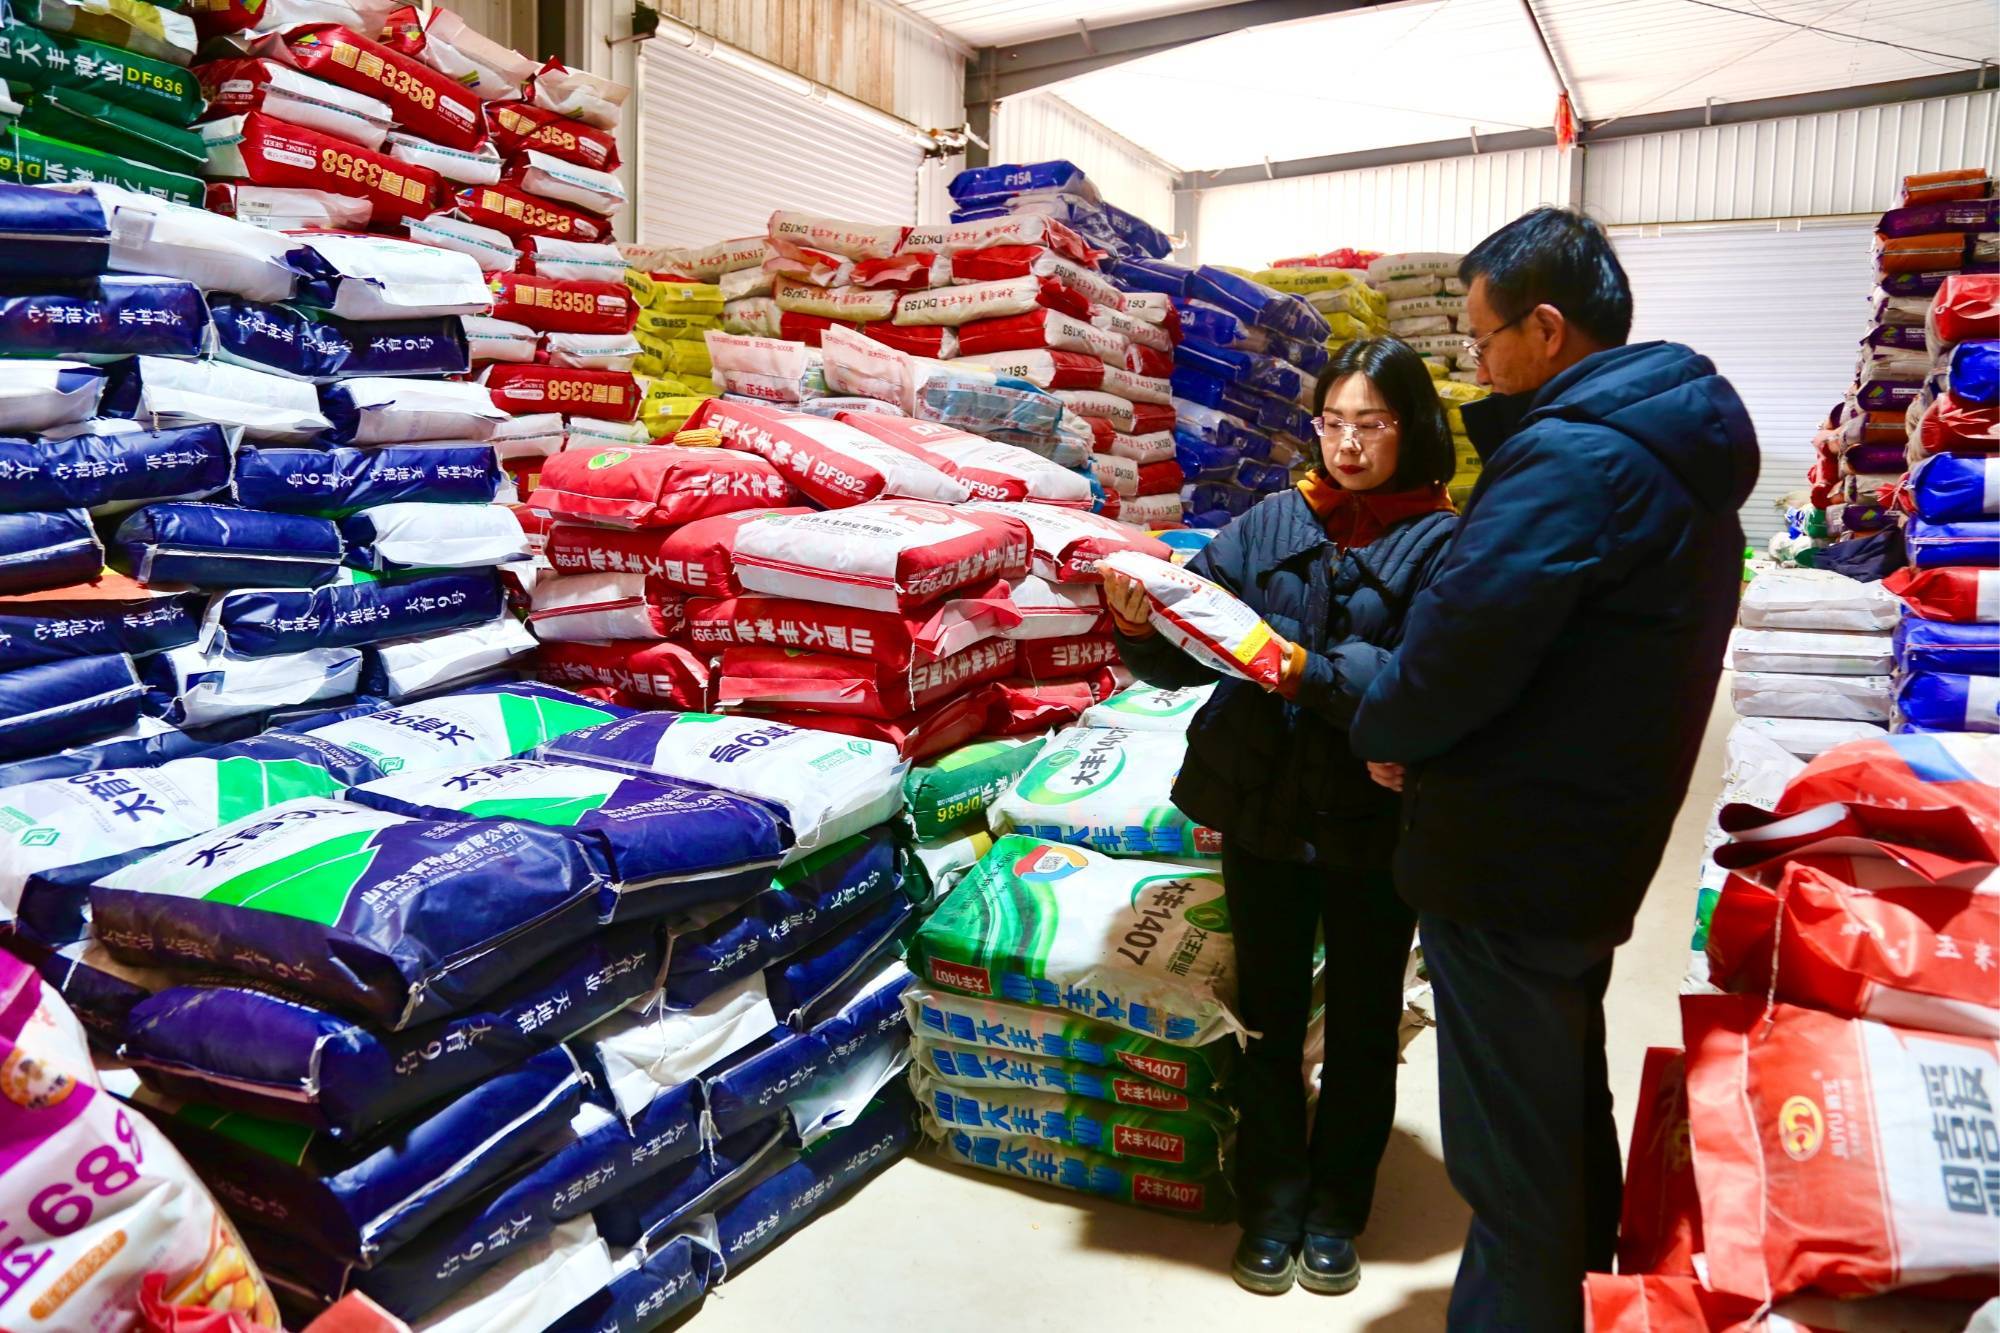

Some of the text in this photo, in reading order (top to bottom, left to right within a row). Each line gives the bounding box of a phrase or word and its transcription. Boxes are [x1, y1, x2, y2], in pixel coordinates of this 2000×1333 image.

[127, 67, 184, 95] DF636
[1005, 171, 1033, 187] F15A
[779, 222, 808, 234] DK193
[908, 234, 943, 246] DK193
[904, 298, 938, 311] DK193
[370, 335, 435, 353] 太育9号
[285, 470, 356, 489] 太育9号
[814, 460, 868, 495] DF992
[959, 476, 1010, 501] DF992
[588, 546, 709, 588] 山西大丰种业
[906, 568, 953, 596] DF992
[405, 589, 467, 613] 太育9号
[735, 617, 875, 656] 山西大丰种业
[708, 723, 808, 764] 育9号
[936, 794, 982, 823] DF636
[187, 809, 358, 869] 太育9
[360, 822, 518, 906] 山西太育种业有限公司
[452, 852, 485, 870] SEED
[1117, 880, 1196, 966] 大丰1407
[936, 970, 986, 993] 大丰1407
[1119, 1130, 1180, 1153] 大丰1407
[1138, 1179, 1200, 1203] 大丰1407
